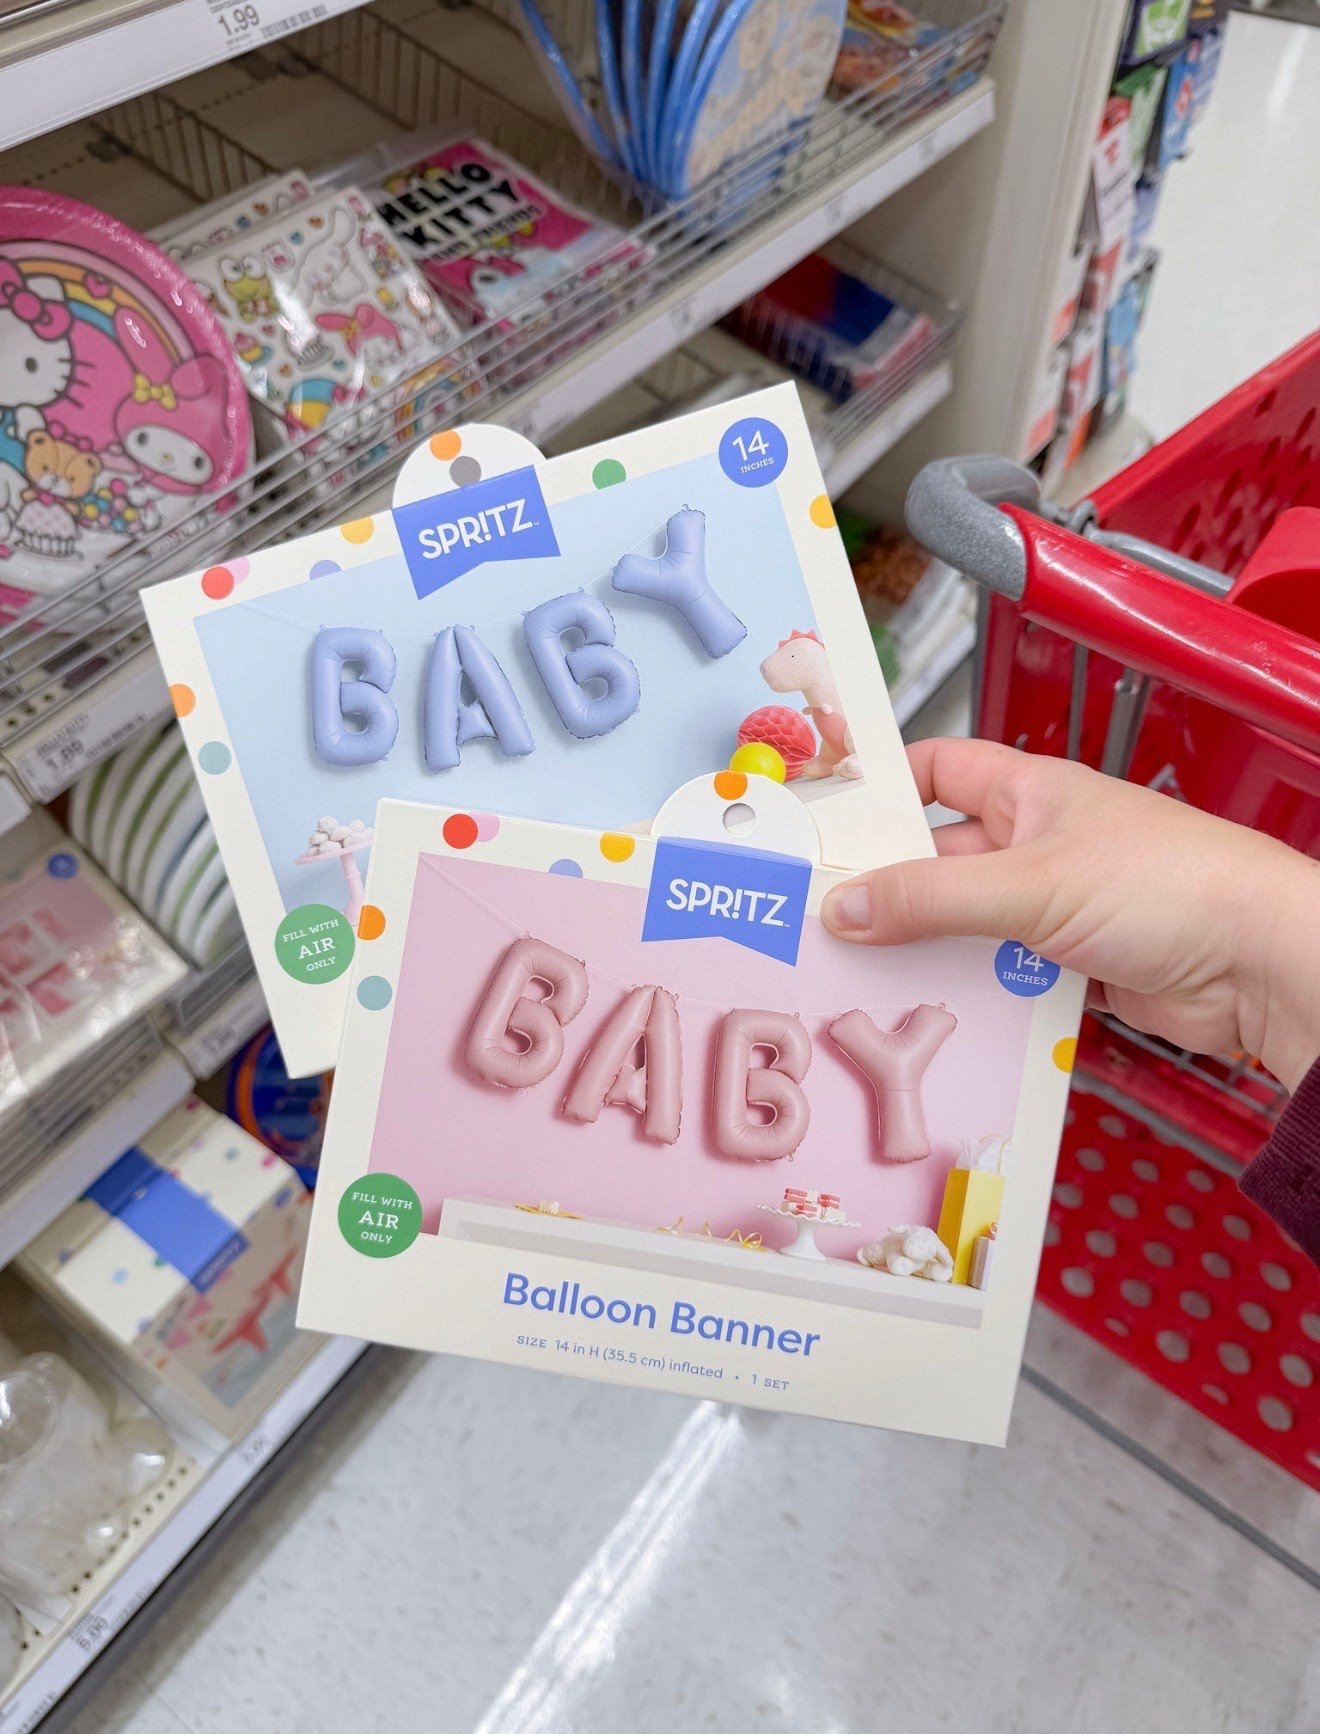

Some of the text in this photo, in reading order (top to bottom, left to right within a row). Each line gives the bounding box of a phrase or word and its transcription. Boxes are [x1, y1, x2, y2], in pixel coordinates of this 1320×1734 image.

[217, 5, 260, 36] 1.99
[376, 163, 491, 226] HELLO
[401, 179, 520, 248] KITTY
[732, 430, 769, 461] 14
[740, 457, 774, 474] INCHES
[311, 503, 748, 774] BABY
[282, 919, 340, 943] FILL WITH
[298, 937, 336, 960] AIR
[1013, 946, 1045, 973] 14
[306, 956, 336, 972] ONLY
[1002, 971, 1049, 986] INCHES
[465, 933, 958, 1163] BABY
[352, 1191, 413, 1211] FILL WITH
[358, 1210, 399, 1230] AIR
[360, 1231, 393, 1244] ONLY
[503, 1272, 821, 1356] Balloon Banner
[517, 1335, 790, 1391] SIZE 14 in H (35.5 cm) inflated 1 SET
